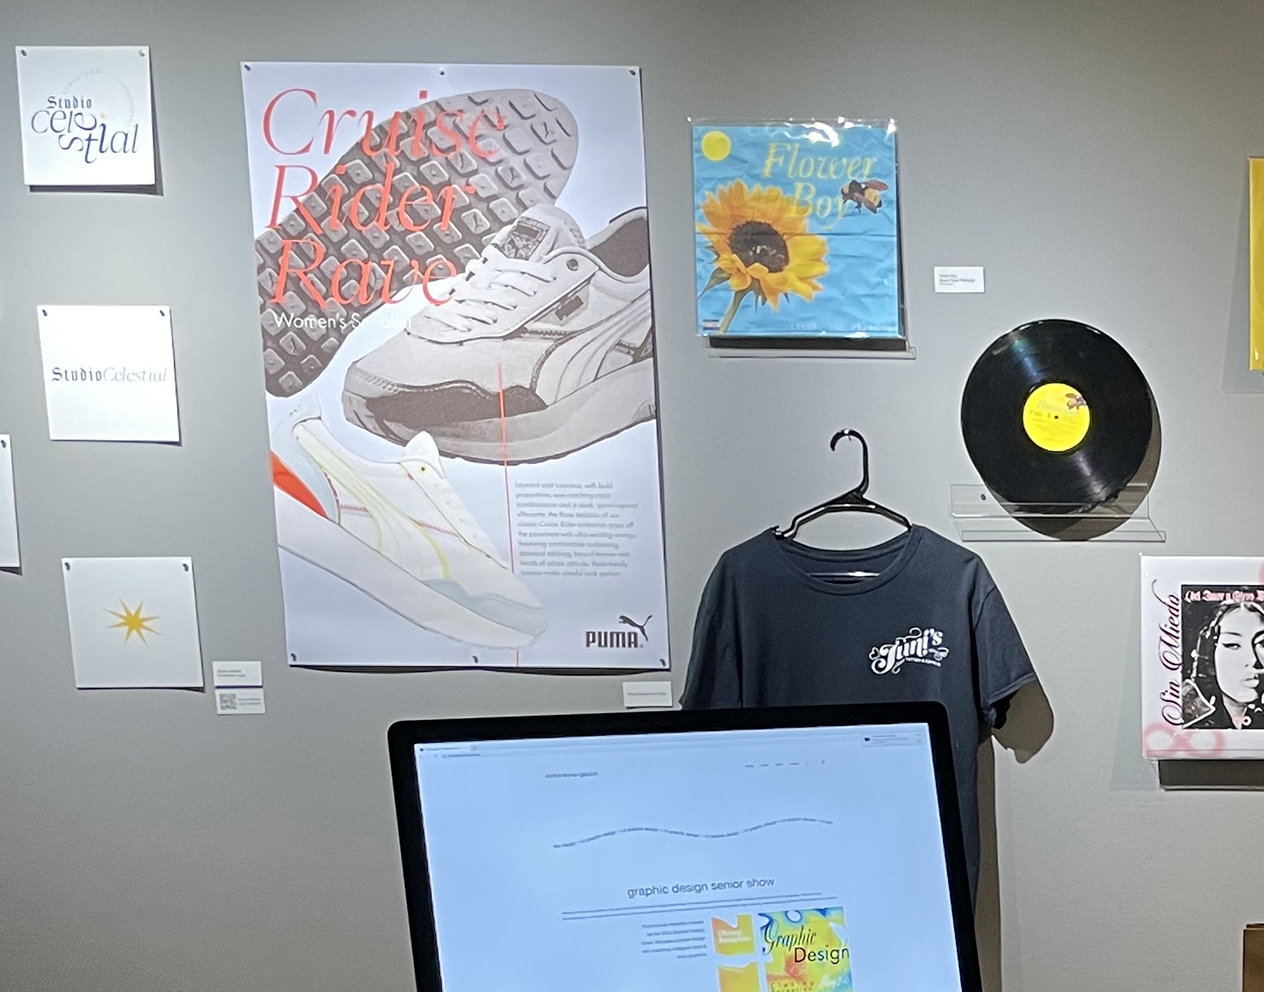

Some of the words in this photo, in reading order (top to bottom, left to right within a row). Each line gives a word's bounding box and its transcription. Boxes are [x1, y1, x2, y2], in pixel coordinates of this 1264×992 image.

[47, 96, 92, 109] Studio
[263, 88, 505, 158] Cruise
[762, 142, 878, 180] Flower
[264, 163, 476, 235] Rider
[787, 182, 846, 230] Boy
[269, 239, 457, 310] Rave
[273, 313, 347, 329] Women's
[585, 631, 638, 649] PUMA
[627, 885, 669, 899] graphic
[672, 882, 708, 896] design
[747, 877, 775, 889] show
[761, 919, 818, 955] Graphic
[794, 947, 850, 964] Design
